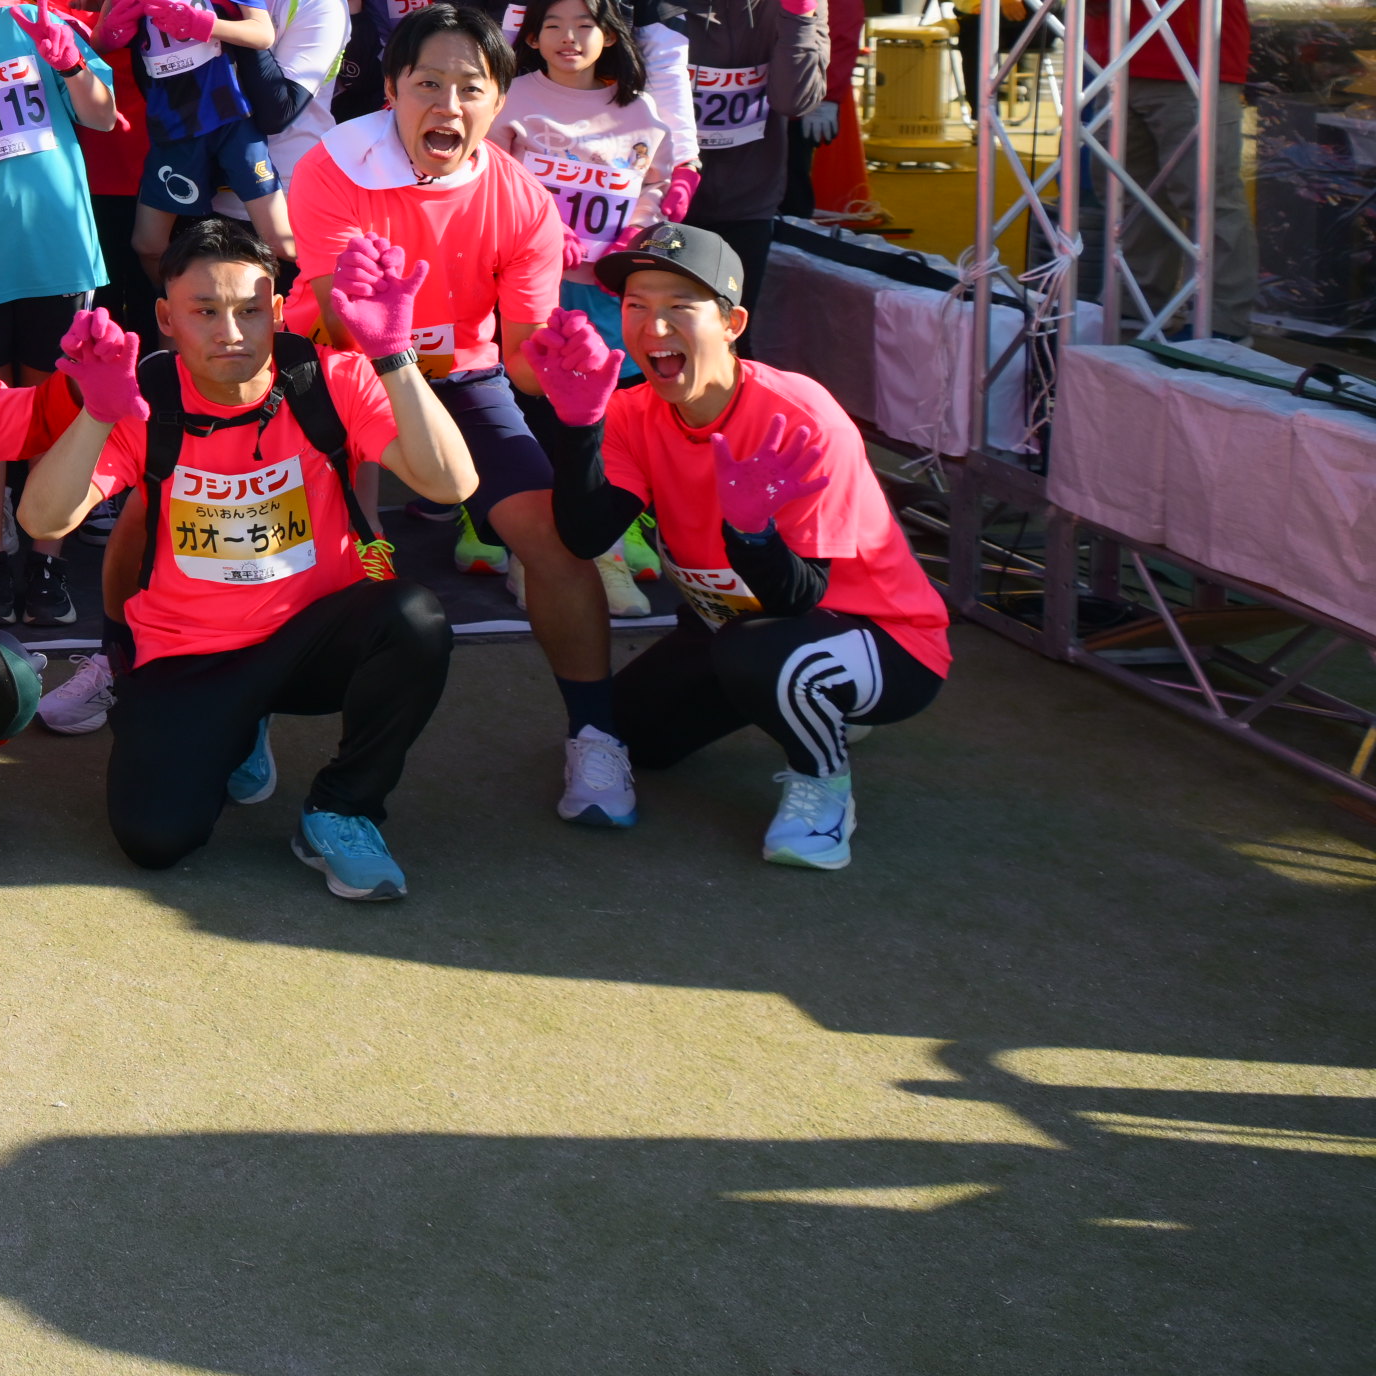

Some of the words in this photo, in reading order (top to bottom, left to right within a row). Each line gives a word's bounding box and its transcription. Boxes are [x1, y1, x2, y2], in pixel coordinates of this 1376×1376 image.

[533, 157, 631, 191] フジパン
[183, 469, 289, 501] フジパン
[195, 500, 281, 520] らいおんうどん
